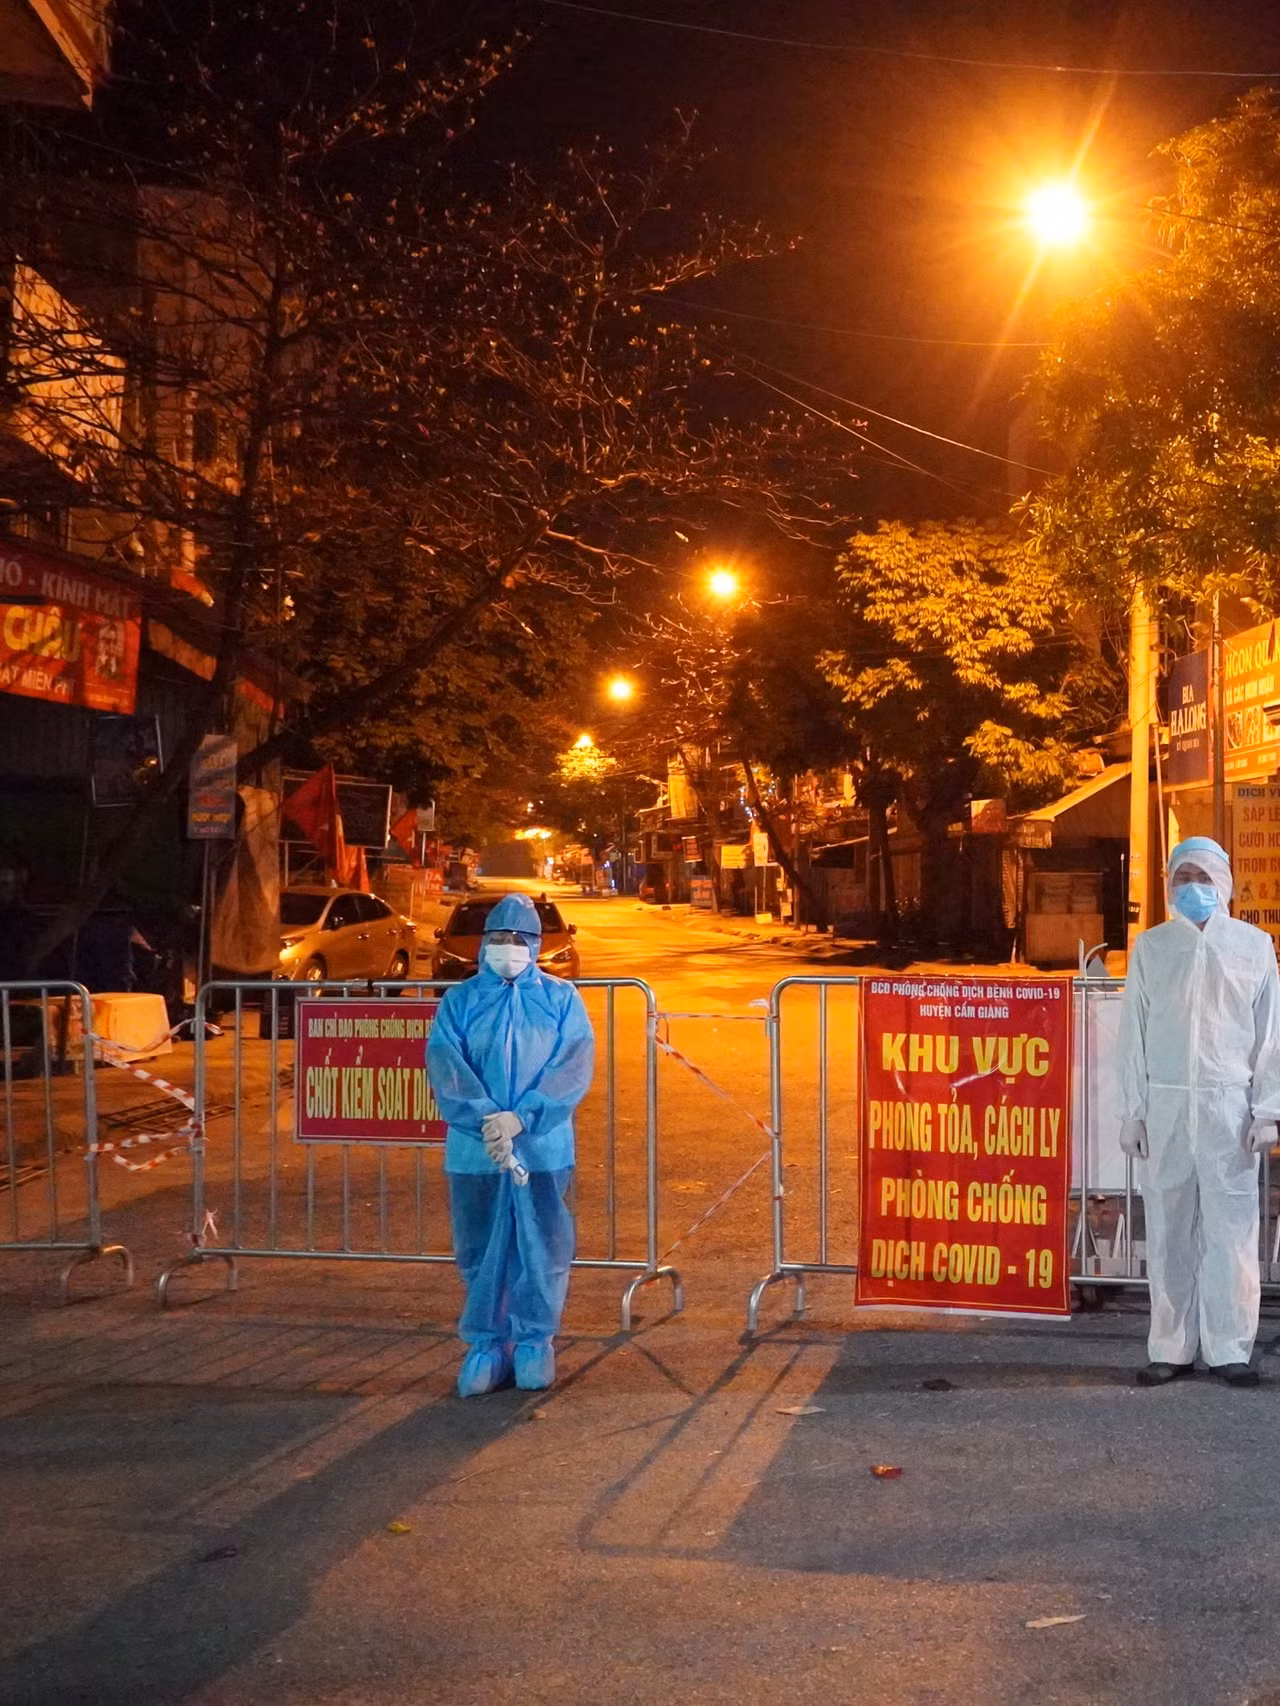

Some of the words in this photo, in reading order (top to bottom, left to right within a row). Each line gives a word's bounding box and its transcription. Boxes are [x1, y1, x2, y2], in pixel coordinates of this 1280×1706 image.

[919, 1003, 952, 1020] HUYỆN
[978, 1004, 1010, 1019] GIÀNG
[962, 985, 984, 1000] DỊCH
[986, 984, 1014, 1000] BỆNH
[1016, 986, 1061, 1001] COVID-19
[306, 1046, 339, 1119] CHỐT
[341, 1044, 374, 1120] KIỂM
[377, 1055, 411, 1120] SOÁT
[882, 1033, 961, 1074] KHU
[972, 1034, 1050, 1084] VỰC
[869, 1100, 932, 1152] PHONG
[937, 1087, 978, 1160] TỎA,
[985, 1094, 1035, 1157] CÁCH
[1040, 1107, 1061, 1158] LY
[880, 1169, 959, 1221] PHÒNG
[967, 1168, 1048, 1226] CHỐNG
[871, 1239, 926, 1288] DỊCH
[932, 1243, 1001, 1286] COVID
[1007, 1264, 1018, 1275] -
[1024, 1248, 1054, 1289] 19
